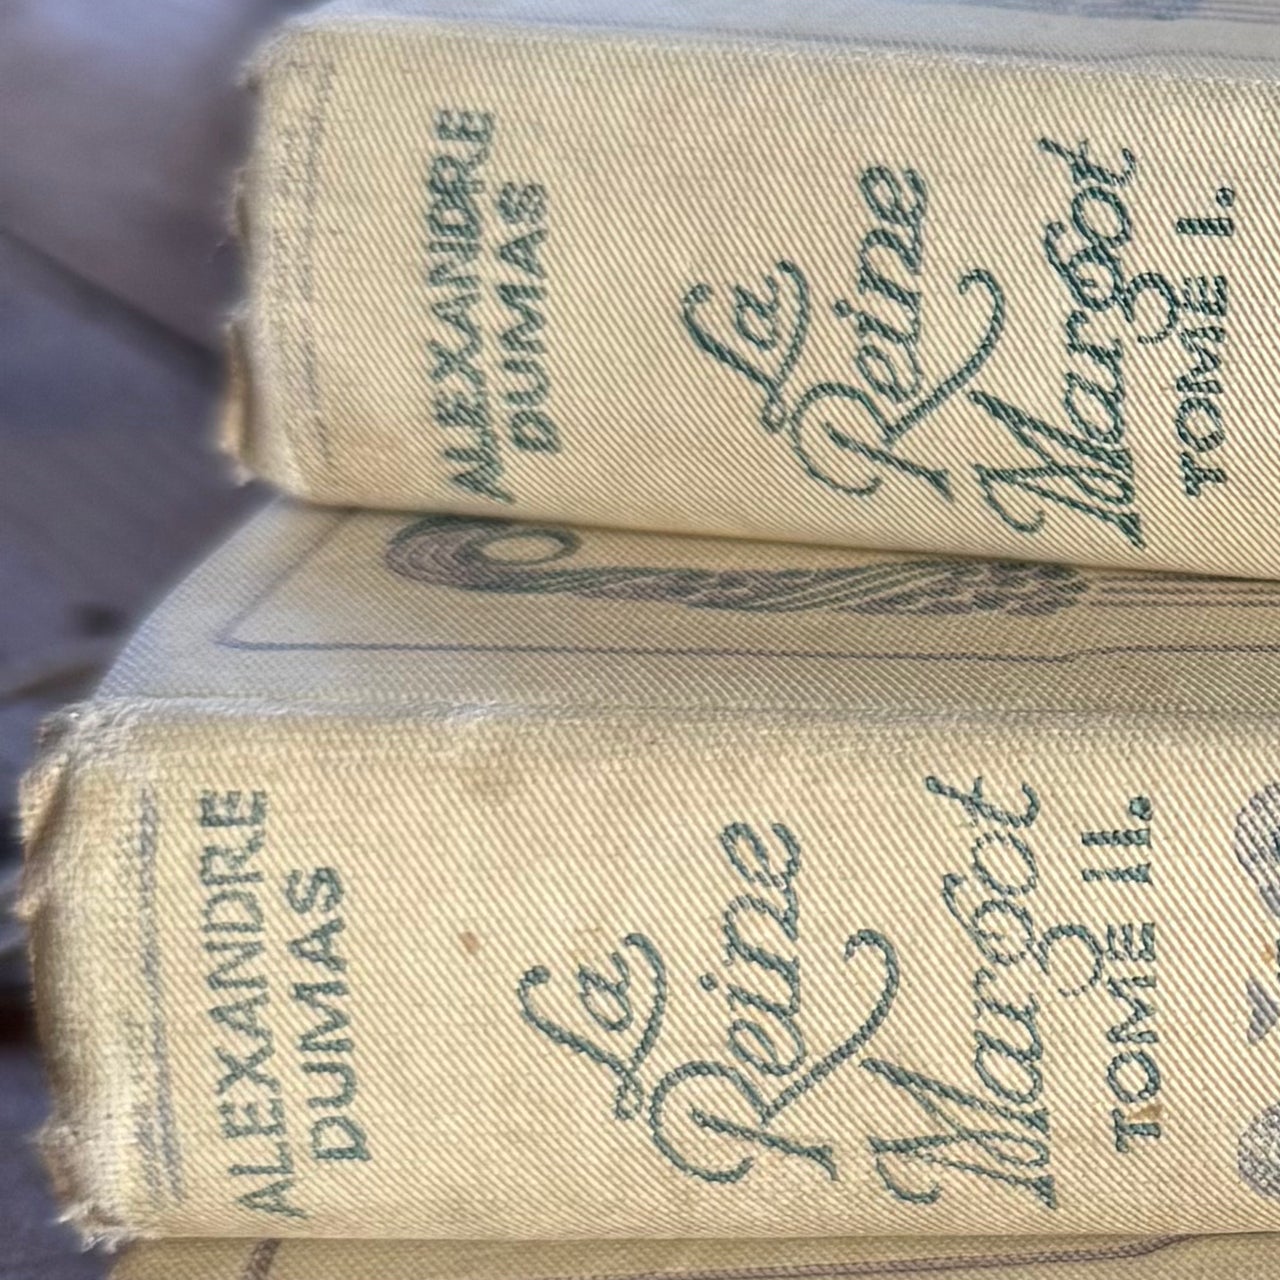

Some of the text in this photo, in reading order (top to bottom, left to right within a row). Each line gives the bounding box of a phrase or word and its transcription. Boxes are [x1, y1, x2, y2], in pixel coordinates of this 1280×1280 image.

[426, 109, 514, 504] ALEXANDRE
[496, 182, 563, 455] DUMAS
[681, 260, 810, 432] La
[791, 164, 1004, 501] Reine
[969, 137, 1183, 548] Margot
[1175, 185, 1236, 497] TOME I.
[200, 789, 306, 1218] ALEXANDRE
[284, 866, 372, 1162] DUMAS
[518, 934, 666, 1121] La
[651, 822, 899, 1183] Reine
[858, 775, 1106, 1210] Margot
[1080, 794, 1162, 1154] TOME II.
